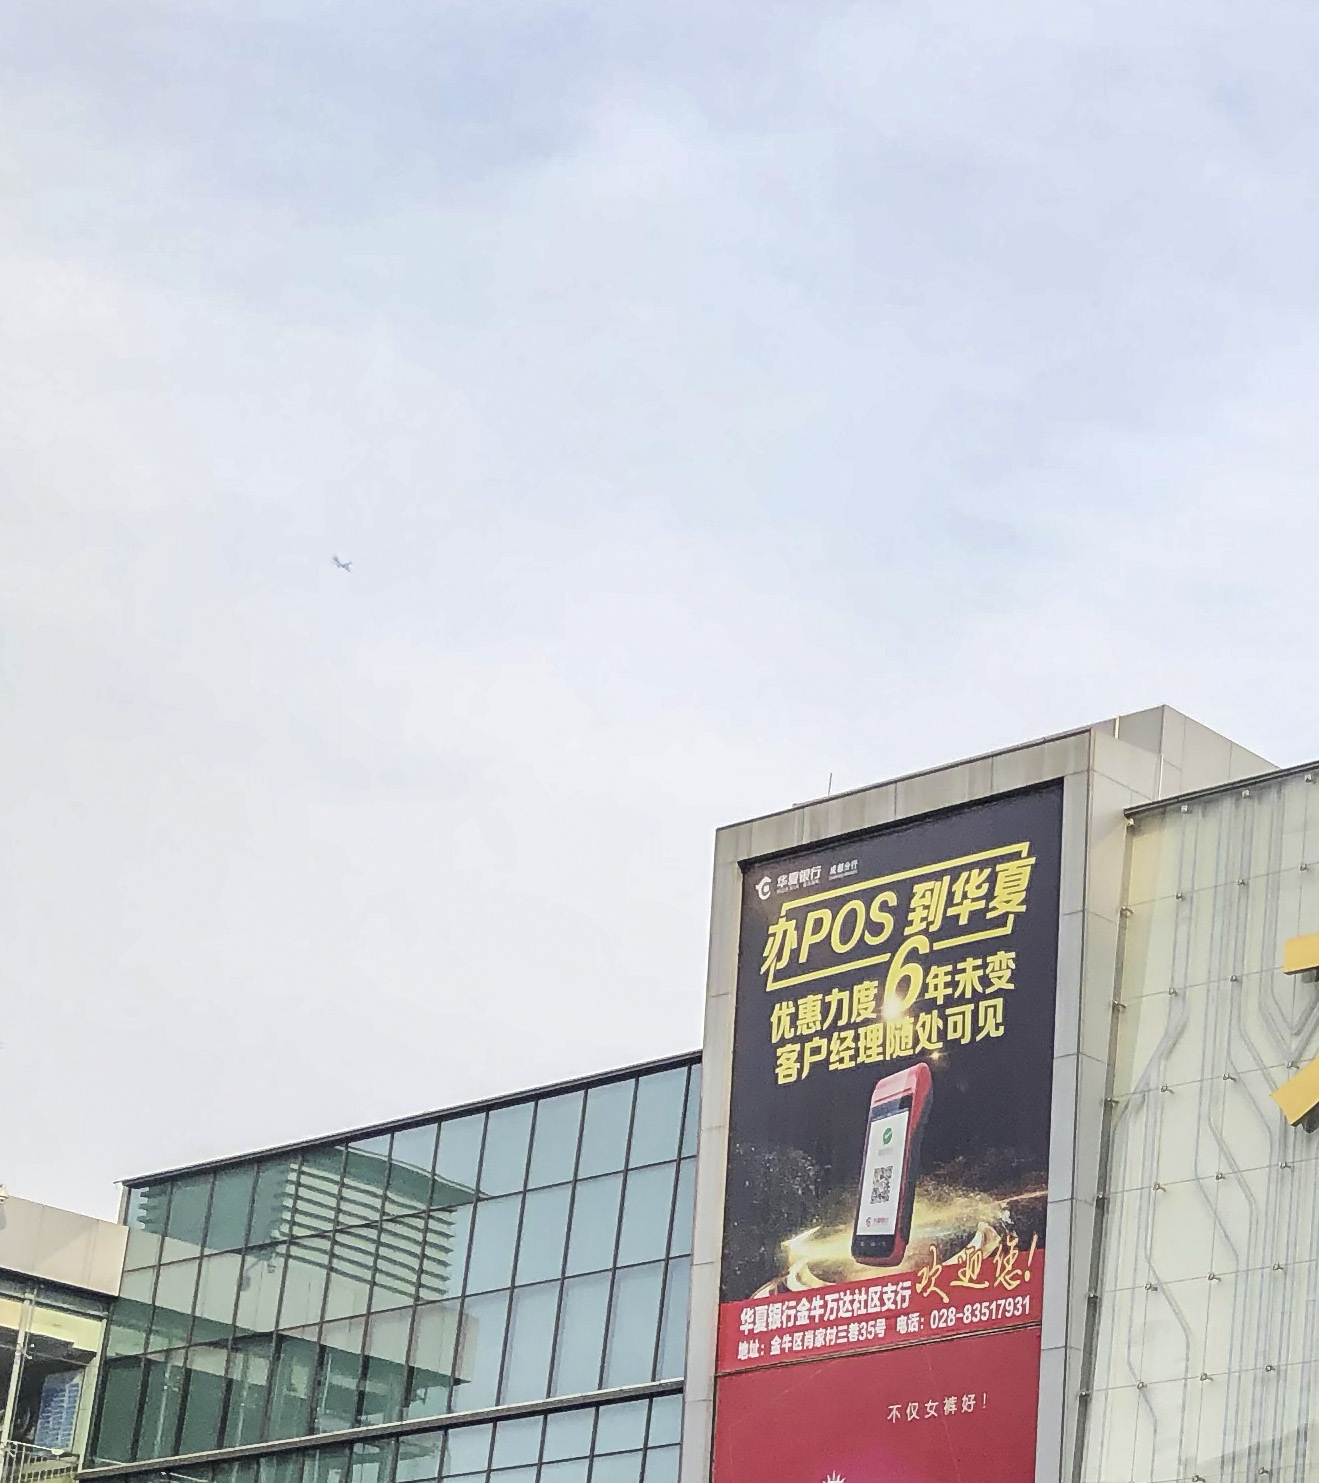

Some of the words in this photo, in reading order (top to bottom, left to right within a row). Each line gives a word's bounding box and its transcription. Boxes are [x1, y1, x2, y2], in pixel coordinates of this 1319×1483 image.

[770, 936, 1016, 1044] 优惠力度6年未变
[775, 1003, 1005, 1086] 客户经理随处可见
[740, 1281, 912, 1335] 华夏银行金牛万达社区支行
